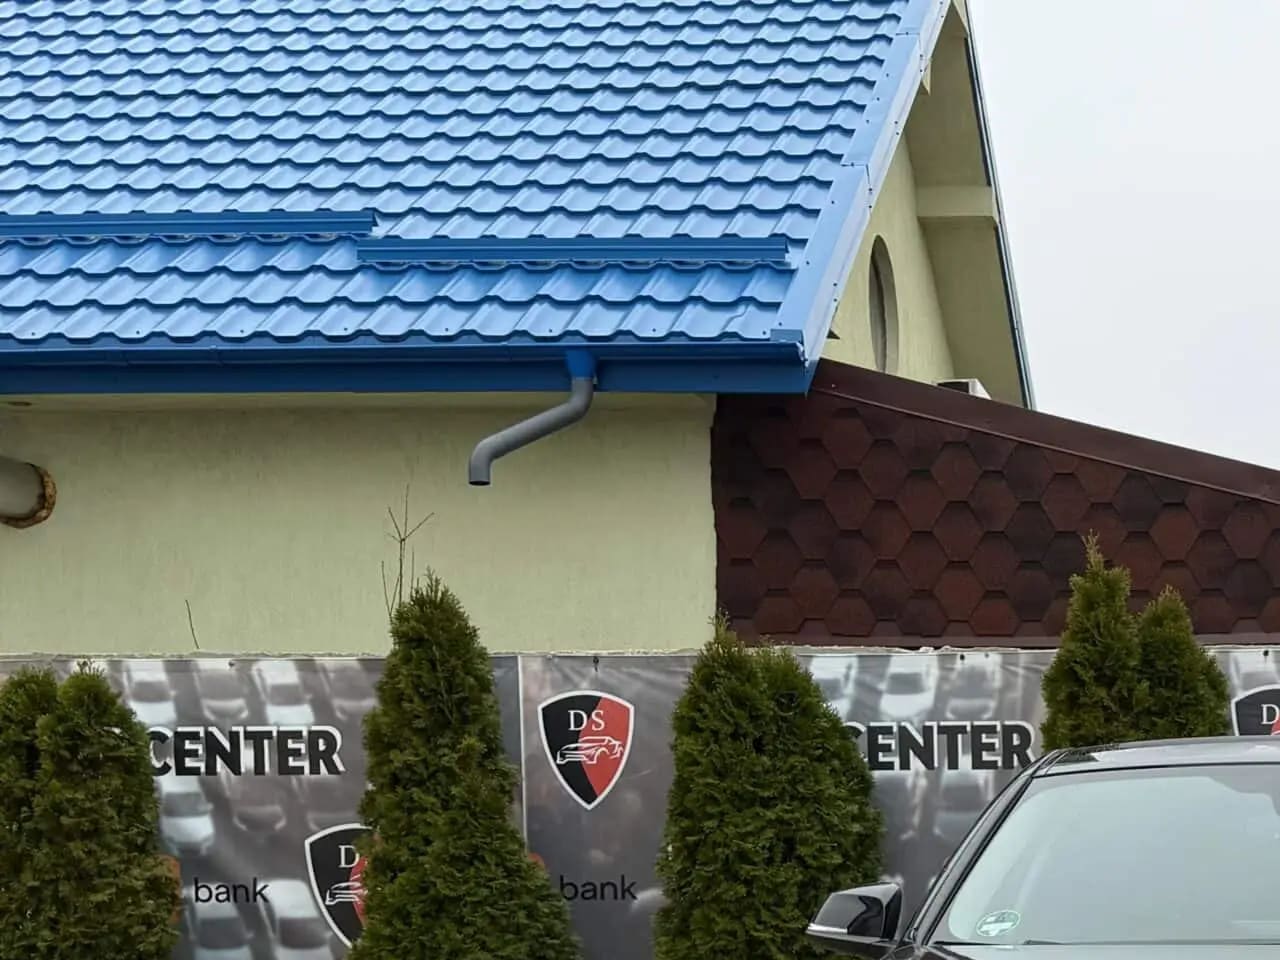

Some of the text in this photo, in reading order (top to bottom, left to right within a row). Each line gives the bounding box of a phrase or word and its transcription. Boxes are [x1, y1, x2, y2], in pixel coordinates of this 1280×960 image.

[567, 709, 606, 731] DS
[337, 845, 360, 868] D
[193, 877, 270, 903] bank
[559, 874, 639, 901] bank
